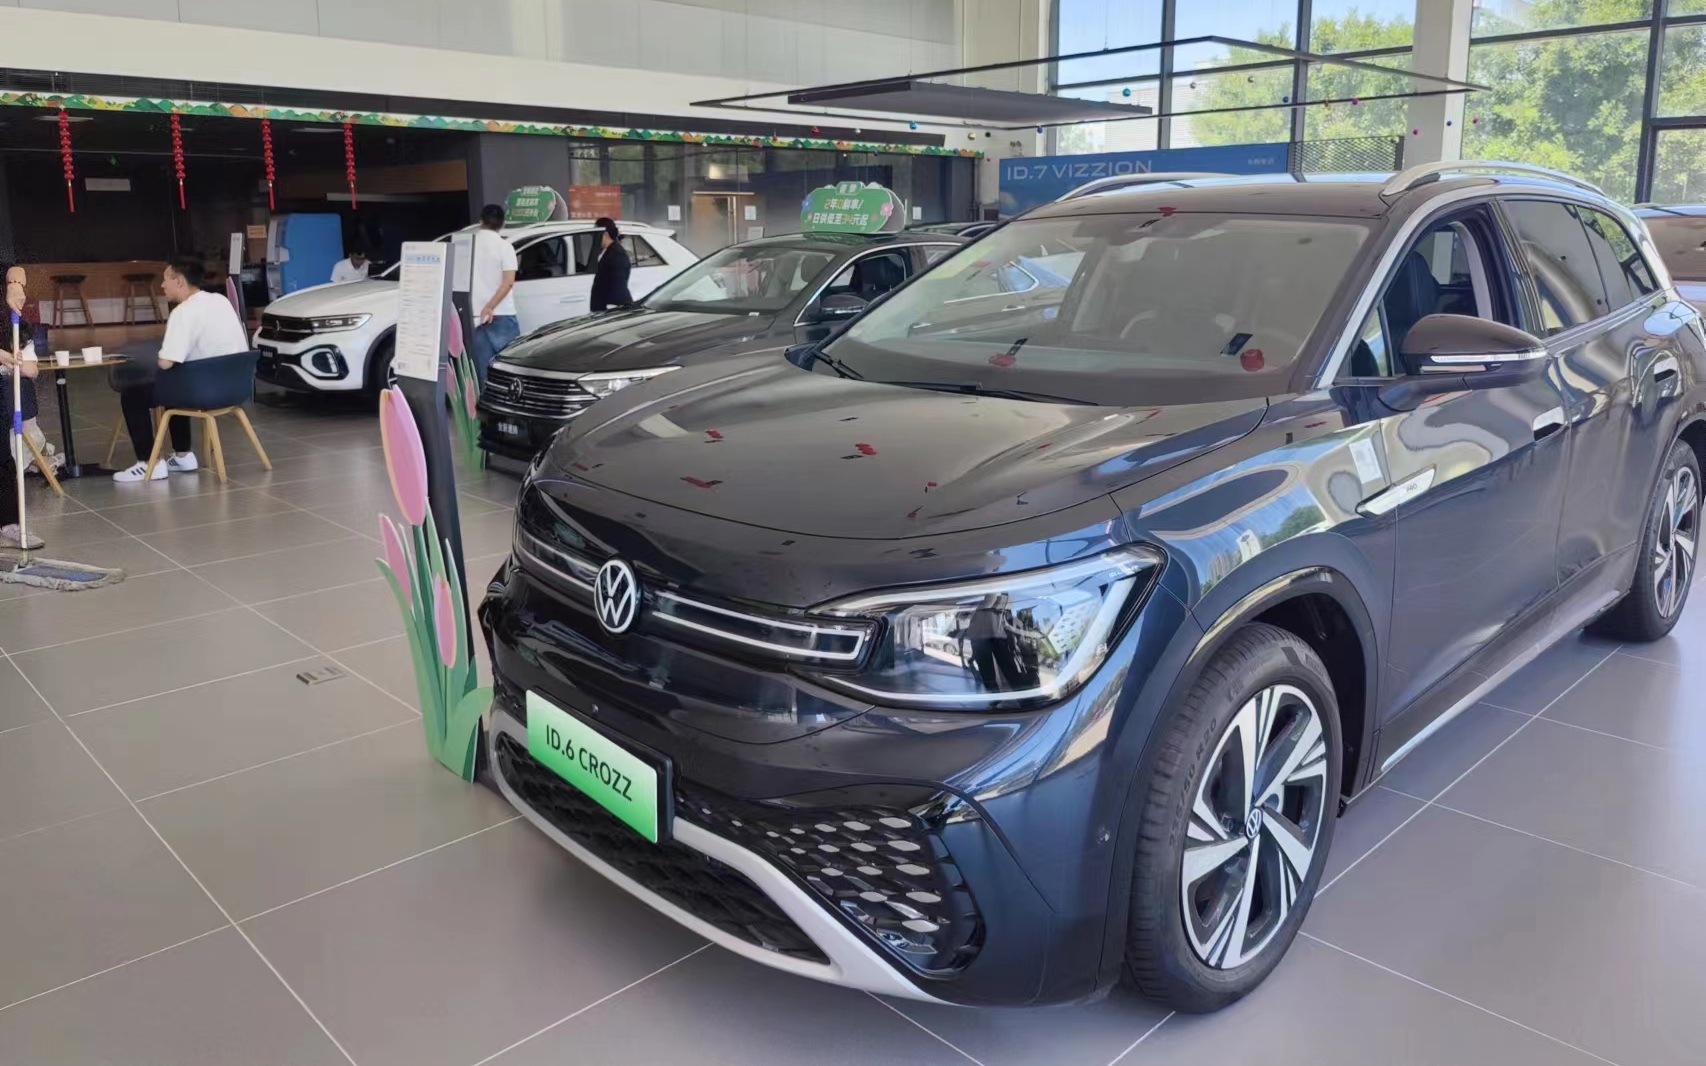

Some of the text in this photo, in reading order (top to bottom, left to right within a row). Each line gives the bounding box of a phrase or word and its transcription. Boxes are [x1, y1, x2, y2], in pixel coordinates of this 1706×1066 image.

[1008, 160, 1153, 180] ID.7 VIZZION
[546, 724, 632, 801] ID.6 CROZZ
